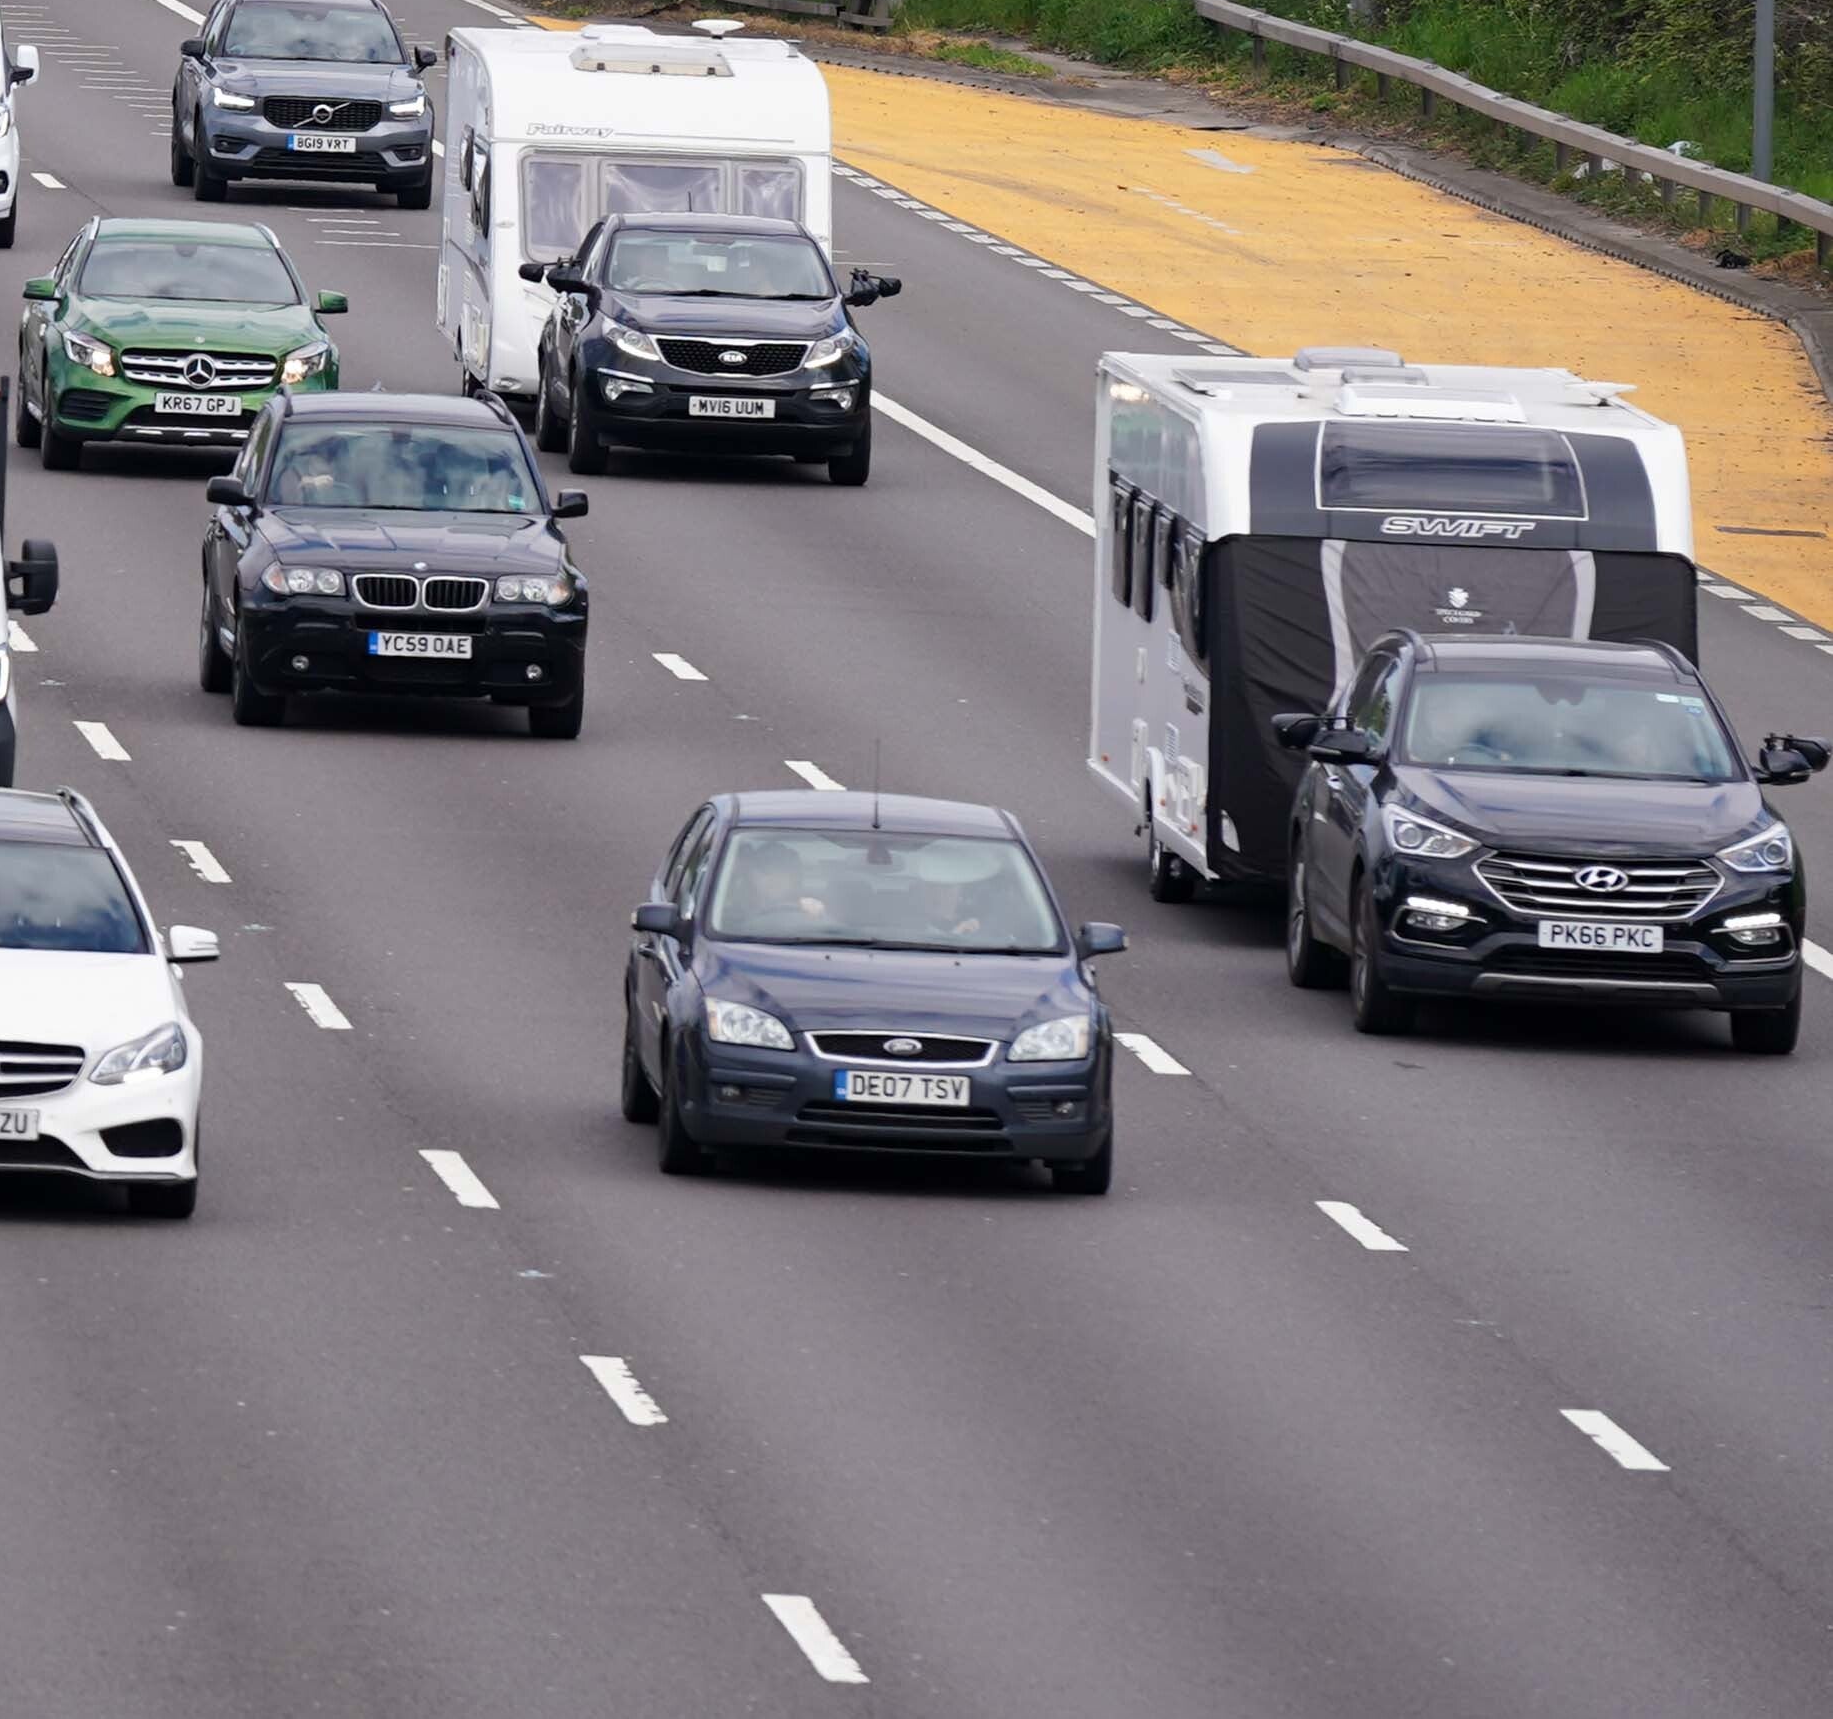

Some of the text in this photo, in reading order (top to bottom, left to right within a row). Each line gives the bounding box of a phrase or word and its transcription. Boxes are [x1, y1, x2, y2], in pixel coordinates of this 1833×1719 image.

[527, 123, 613, 138] Fairway
[297, 137, 349, 149] BG19 VRT
[723, 354, 743, 363] KIA
[162, 395, 236, 413] KR67 GPJ
[699, 399, 764, 416] MV16 UUM
[1381, 516, 1537, 538] SWIFT
[382, 635, 469, 654] YC59 OAE
[1551, 919, 1654, 947] PK66 PKC
[852, 1075, 965, 1099] DE07 TSV
